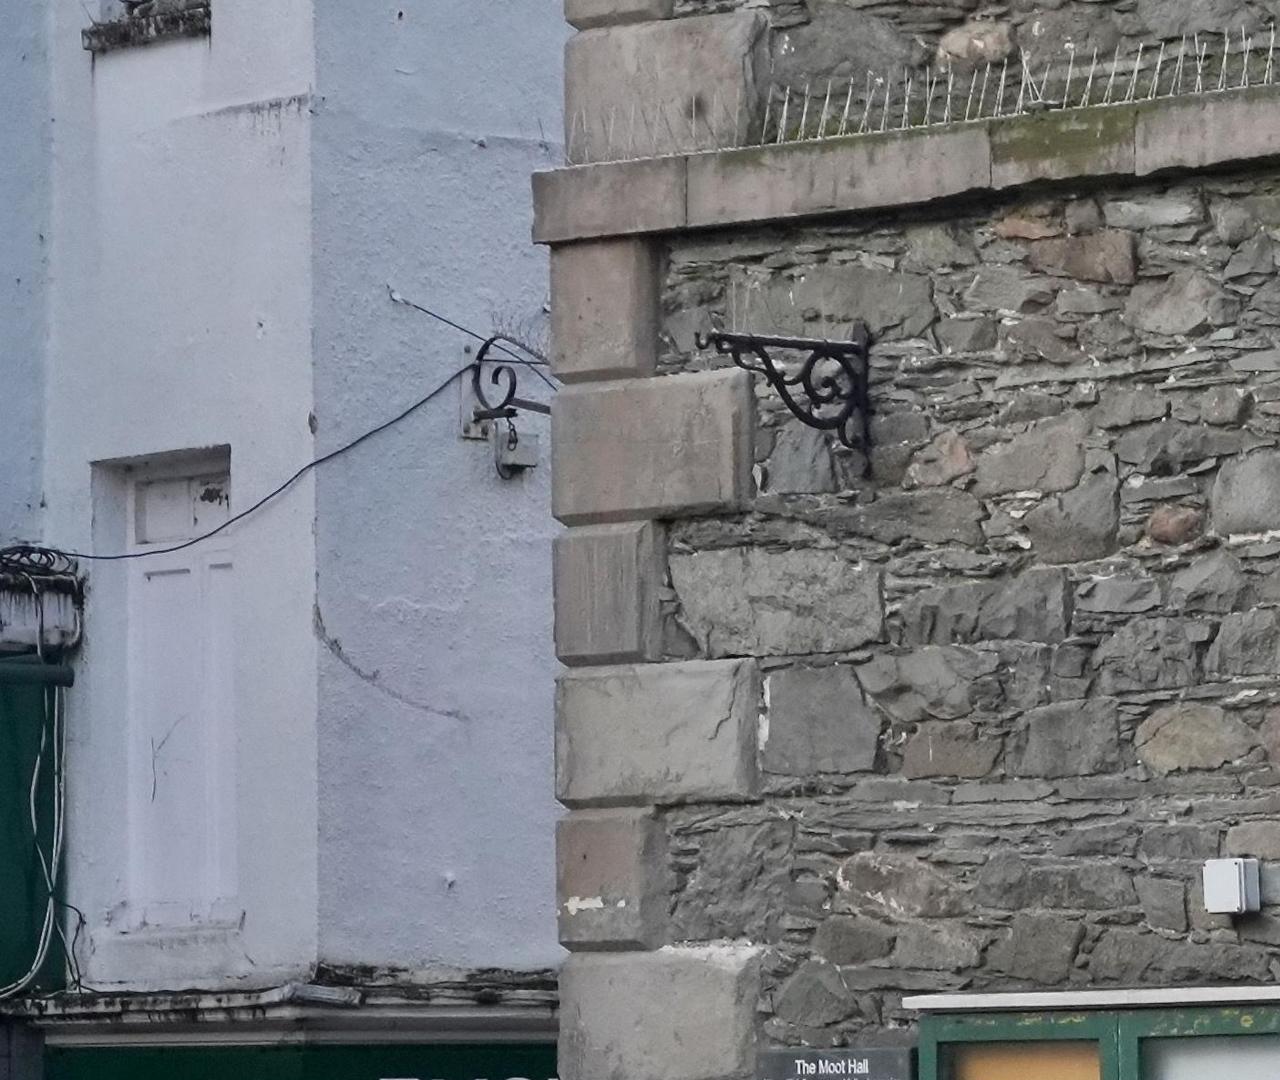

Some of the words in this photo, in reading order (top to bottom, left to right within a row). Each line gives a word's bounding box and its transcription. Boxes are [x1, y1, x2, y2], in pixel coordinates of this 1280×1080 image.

[795, 1060, 816, 1074] The
[819, 1060, 845, 1074] Moot
[848, 1059, 868, 1074] Hall
